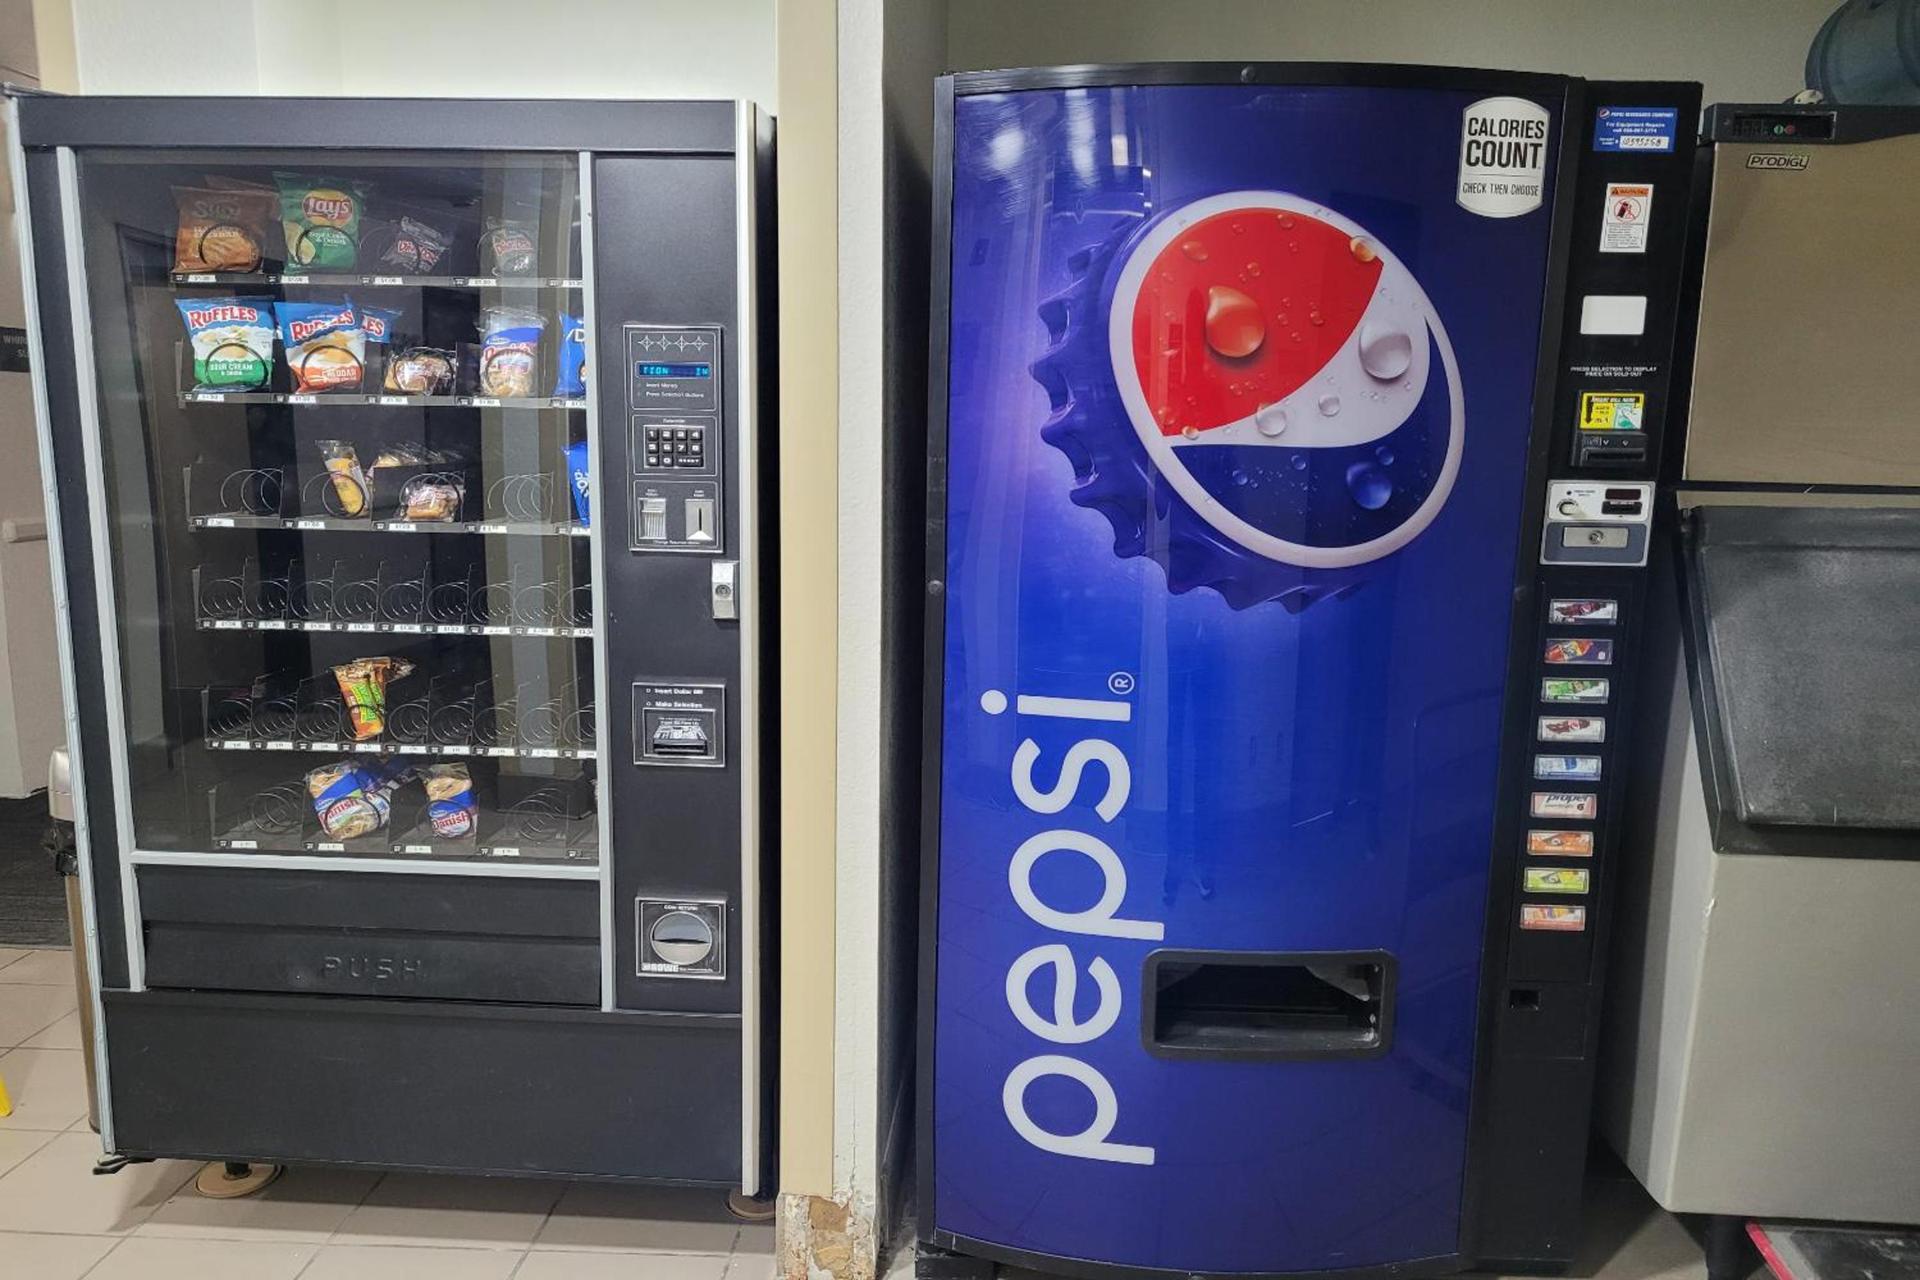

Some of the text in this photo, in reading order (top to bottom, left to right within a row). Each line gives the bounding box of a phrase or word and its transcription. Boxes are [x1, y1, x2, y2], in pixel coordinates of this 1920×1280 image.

[1467, 117, 1545, 139] CALORIES
[1465, 140, 1543, 169] COUNT
[1462, 182, 1539, 196] CHECK THEN CHOOSE
[187, 305, 258, 329] RUFFLES
[210, 363, 253, 372] SOUR CREAM
[980, 688, 1165, 1166] pepsi
[323, 956, 422, 979] PUSH
